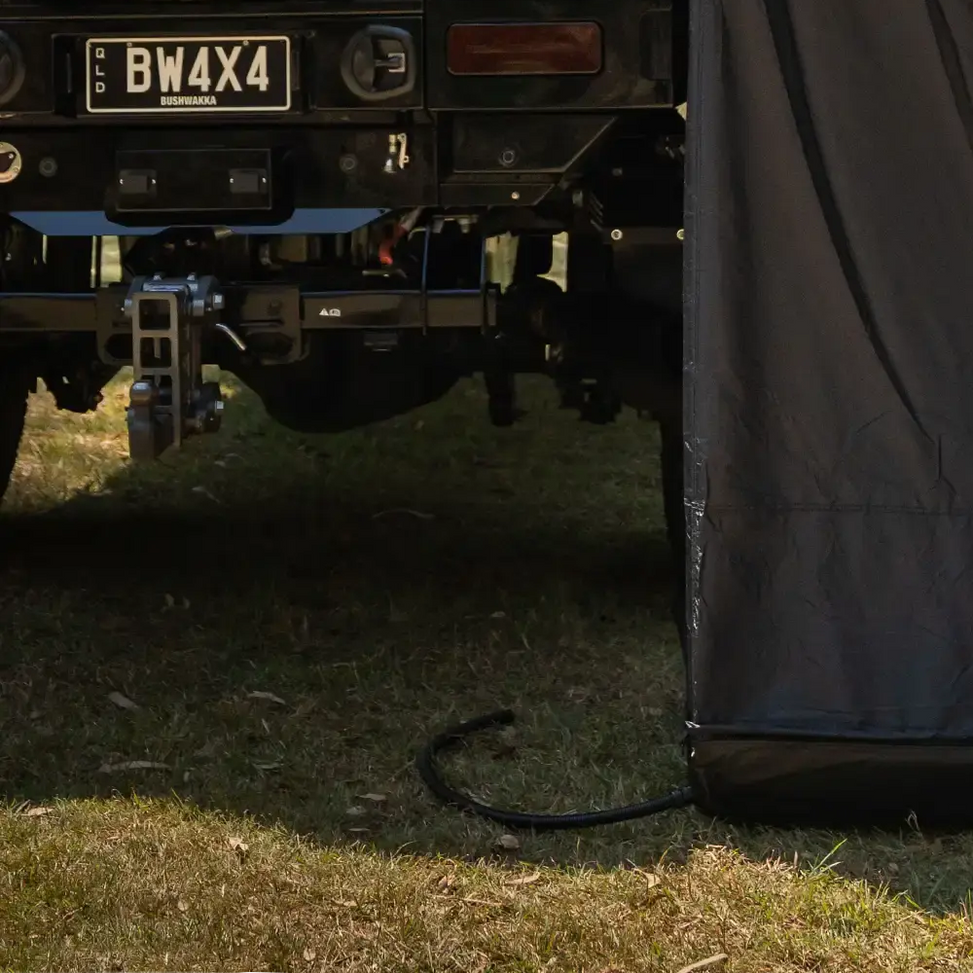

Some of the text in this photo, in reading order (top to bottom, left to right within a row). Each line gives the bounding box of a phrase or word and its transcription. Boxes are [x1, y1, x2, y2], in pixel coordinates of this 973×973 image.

[95, 47, 106, 93] QLD
[126, 45, 269, 93] BW4X4
[160, 96, 217, 106] BUSHWAKKA
